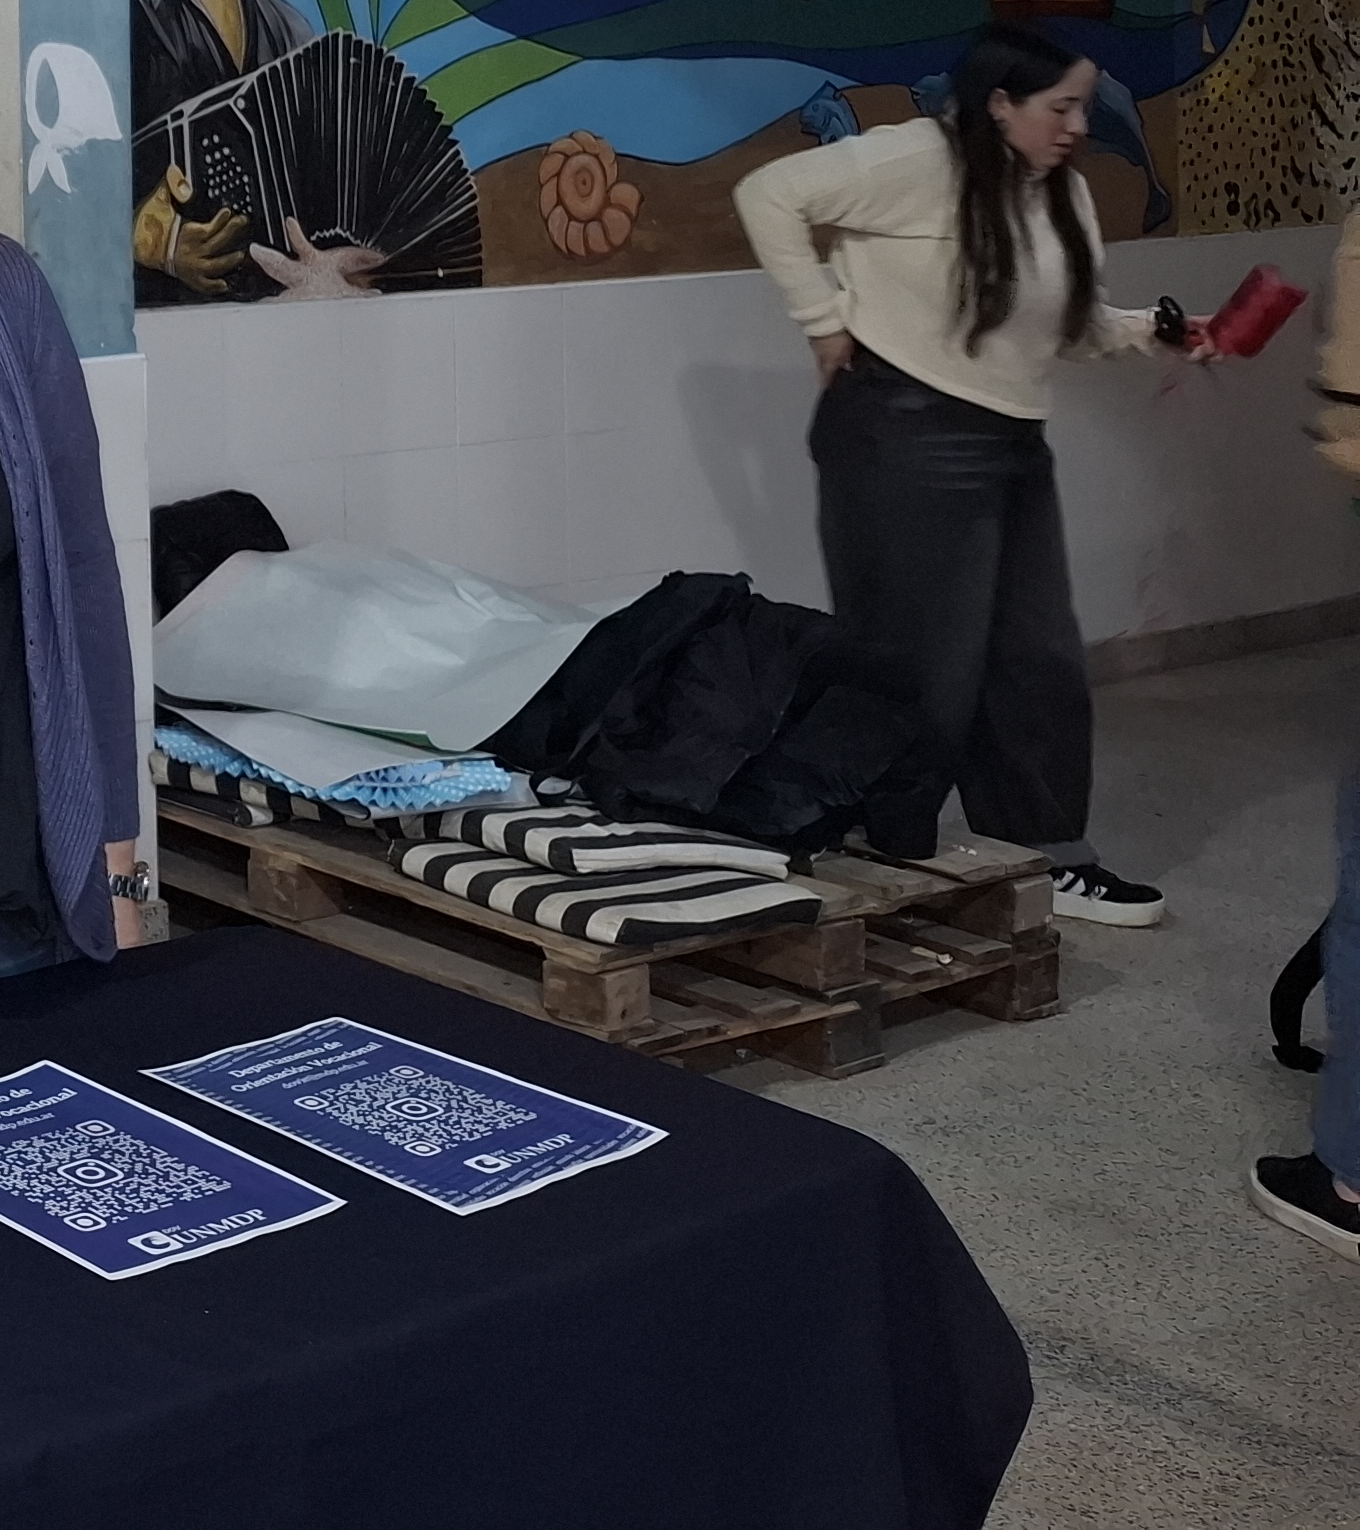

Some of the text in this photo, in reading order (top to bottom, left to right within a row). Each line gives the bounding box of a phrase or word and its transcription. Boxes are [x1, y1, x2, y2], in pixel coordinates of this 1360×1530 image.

[228, 1047, 325, 1078] Departamento
[324, 1040, 343, 1051] de
[231, 1064, 309, 1092] Orientación
[308, 1042, 383, 1070] Vocacional
[9, 1087, 33, 1100] de
[501, 1133, 578, 1165] UNMDP
[170, 1208, 267, 1244] UNMDP
